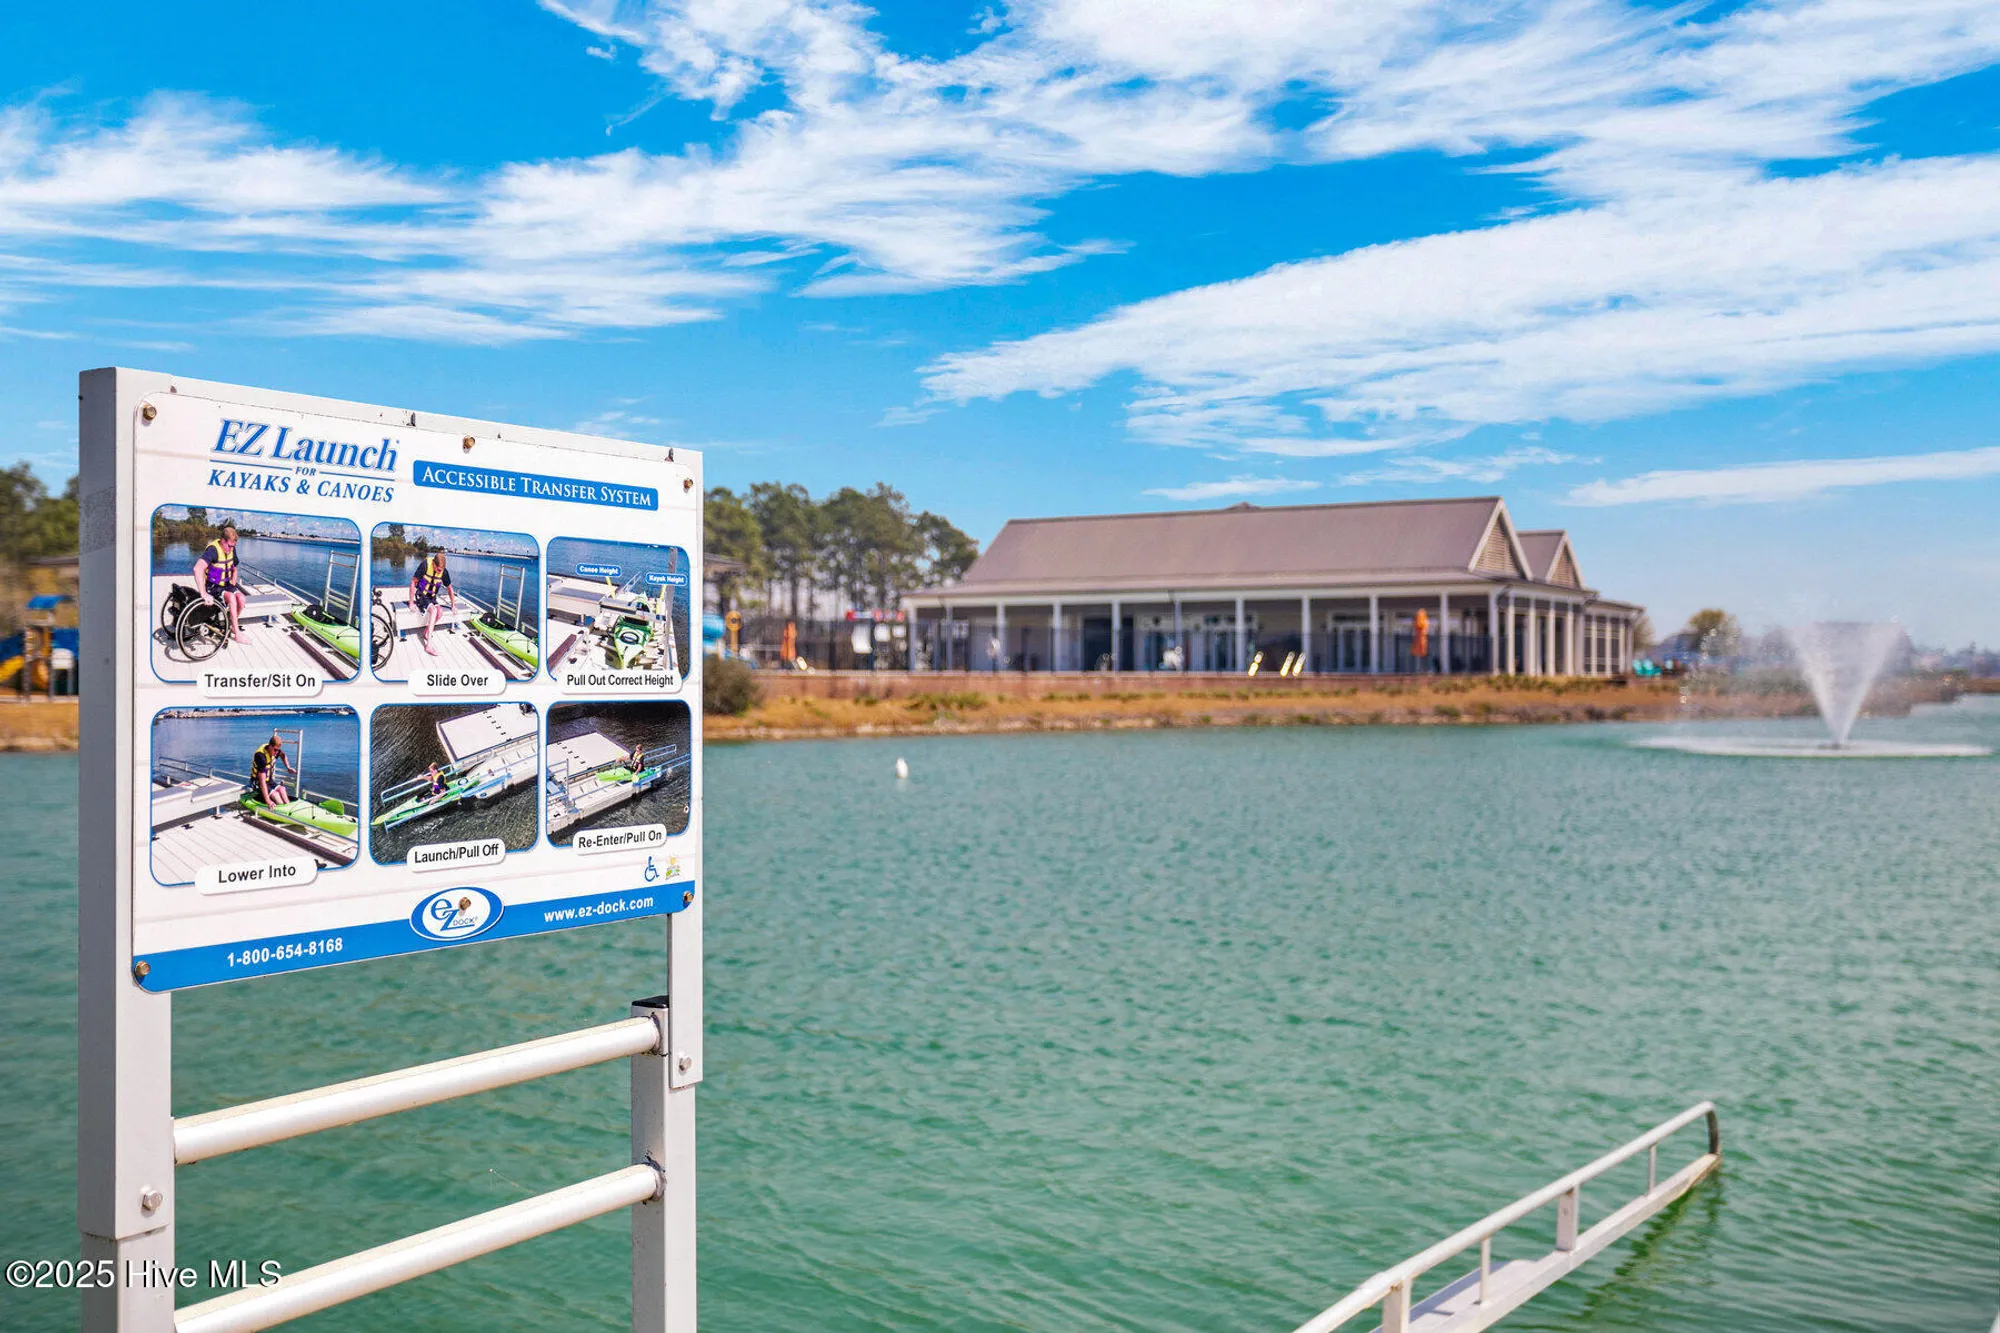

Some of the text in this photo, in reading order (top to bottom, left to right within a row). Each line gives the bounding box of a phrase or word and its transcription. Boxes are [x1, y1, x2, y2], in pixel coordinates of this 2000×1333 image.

[212, 418, 398, 472] EZ Launch
[295, 466, 317, 477] FOR
[207, 469, 395, 504] KAYAKS & CANOES
[422, 466, 652, 507] ACCESSIBLE TRANSFER SYSTEM
[579, 565, 619, 576] Canoe Height
[649, 574, 685, 584] Kayak Height
[204, 673, 316, 688] Transfer/Sit On
[426, 673, 489, 687] Slide Over
[566, 674, 674, 687] Pull Out Correct Height
[578, 829, 662, 849] Re-Enter/Pull On
[414, 843, 499, 864] Launch/Pull Off
[218, 864, 297, 884] Lower Into
[544, 896, 654, 923] www.ez-dock.com
[227, 937, 344, 968] 1-800-654-8168
